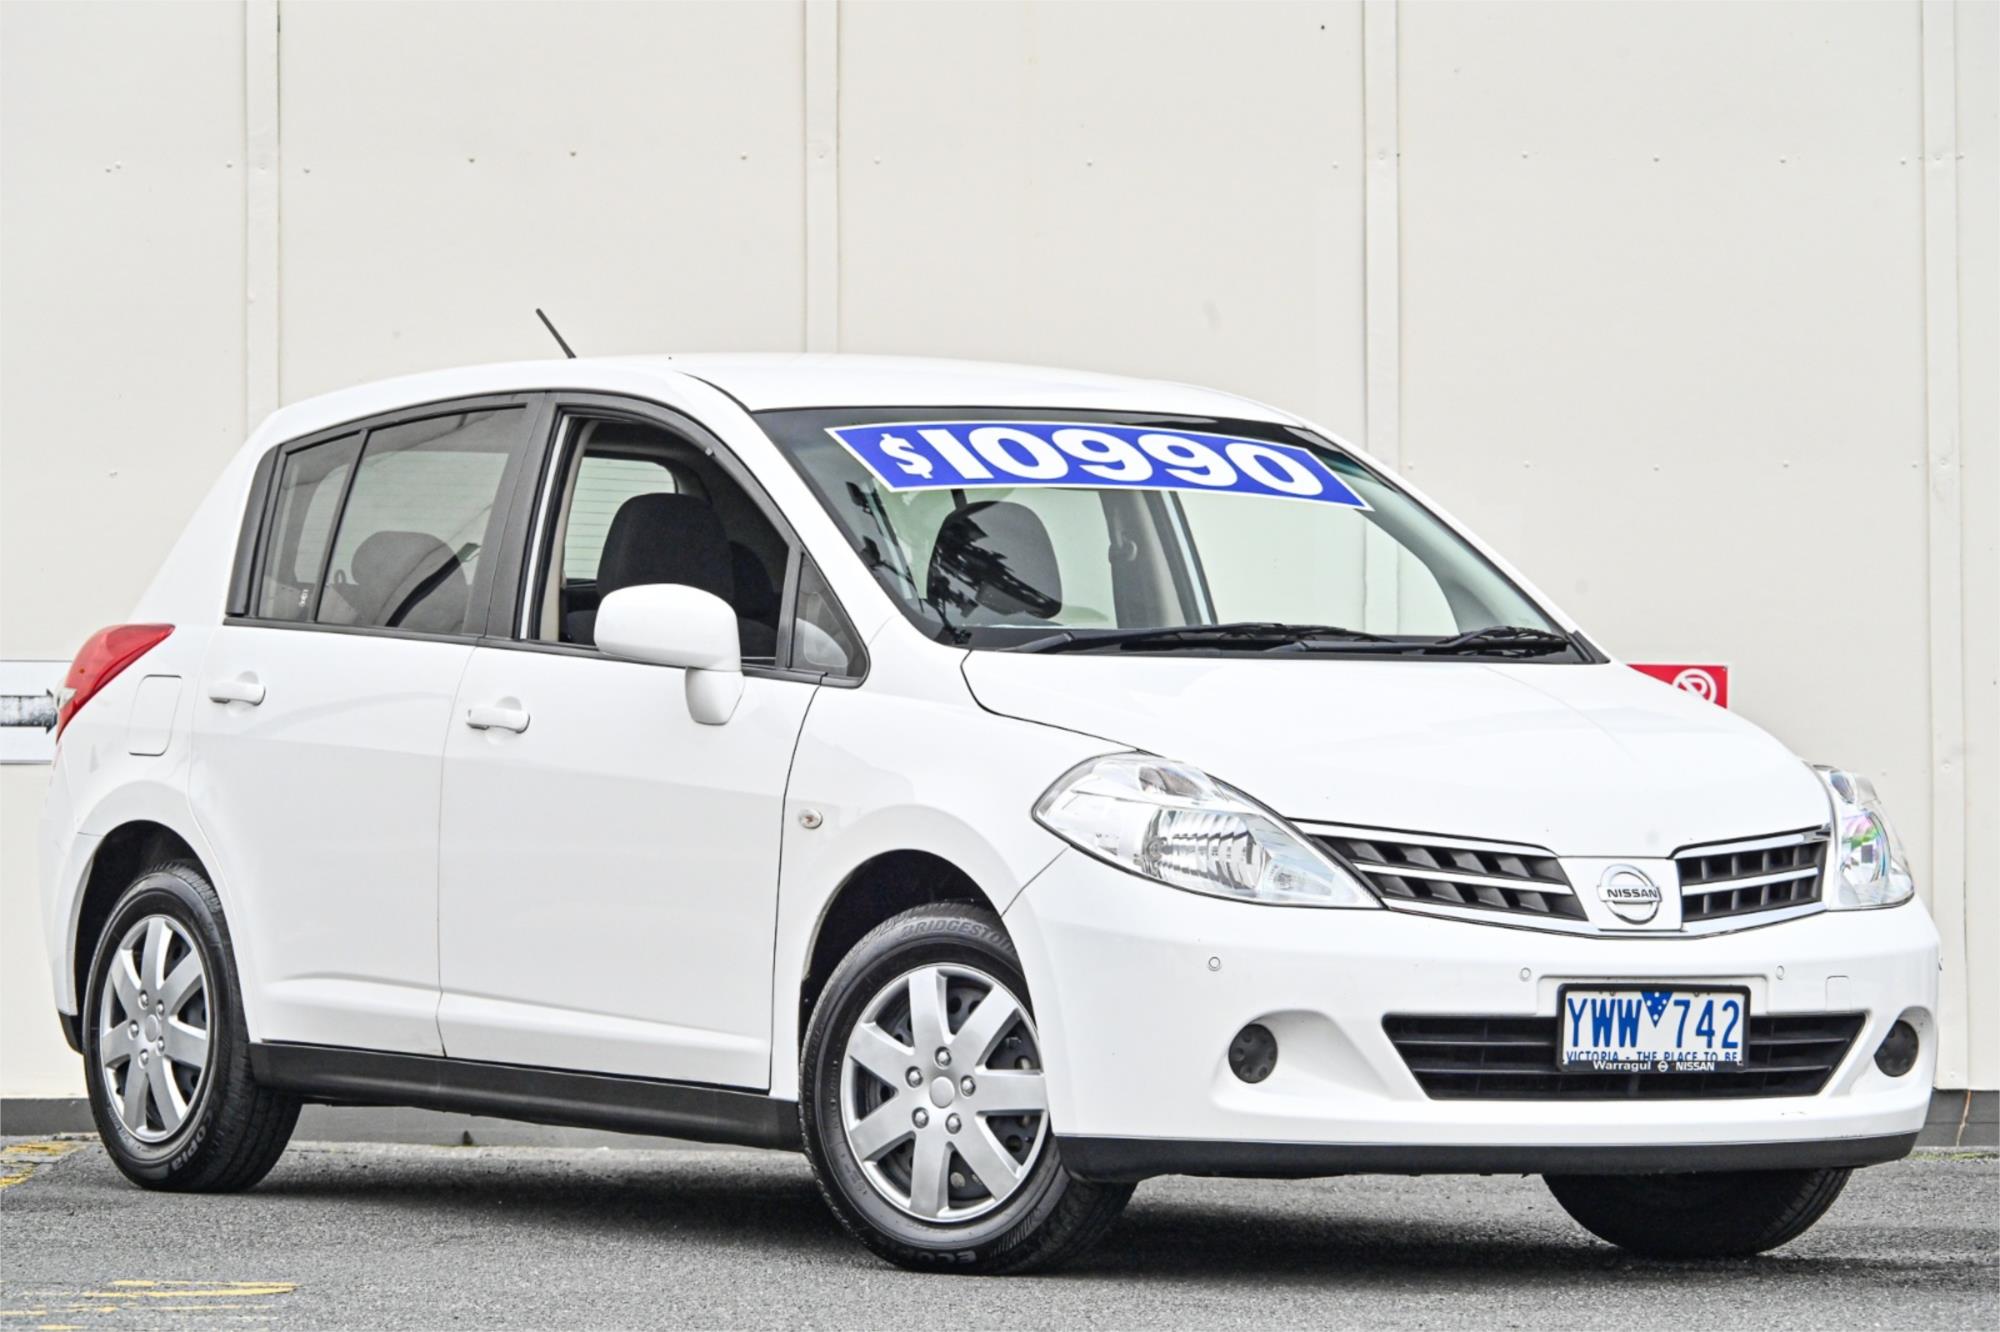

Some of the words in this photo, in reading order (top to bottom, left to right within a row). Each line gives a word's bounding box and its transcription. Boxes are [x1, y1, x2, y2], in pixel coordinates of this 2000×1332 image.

[879, 427, 1324, 497] $10990
[1606, 888, 1658, 898] NISSAN
[902, 920, 1011, 949] BRIDGESTON
[1567, 998, 1642, 1048] YWW
[1673, 999, 1740, 1049] 742
[1566, 1051, 1619, 1061] VICTORIA
[1637, 1051, 1657, 1061] THE
[1664, 1051, 1698, 1061] PLACE
[1704, 1052, 1718, 1061] TO
[1725, 1052, 1738, 1061] BE
[1593, 1060, 1651, 1072] Warragul
[1676, 1061, 1715, 1071] NISSAN
